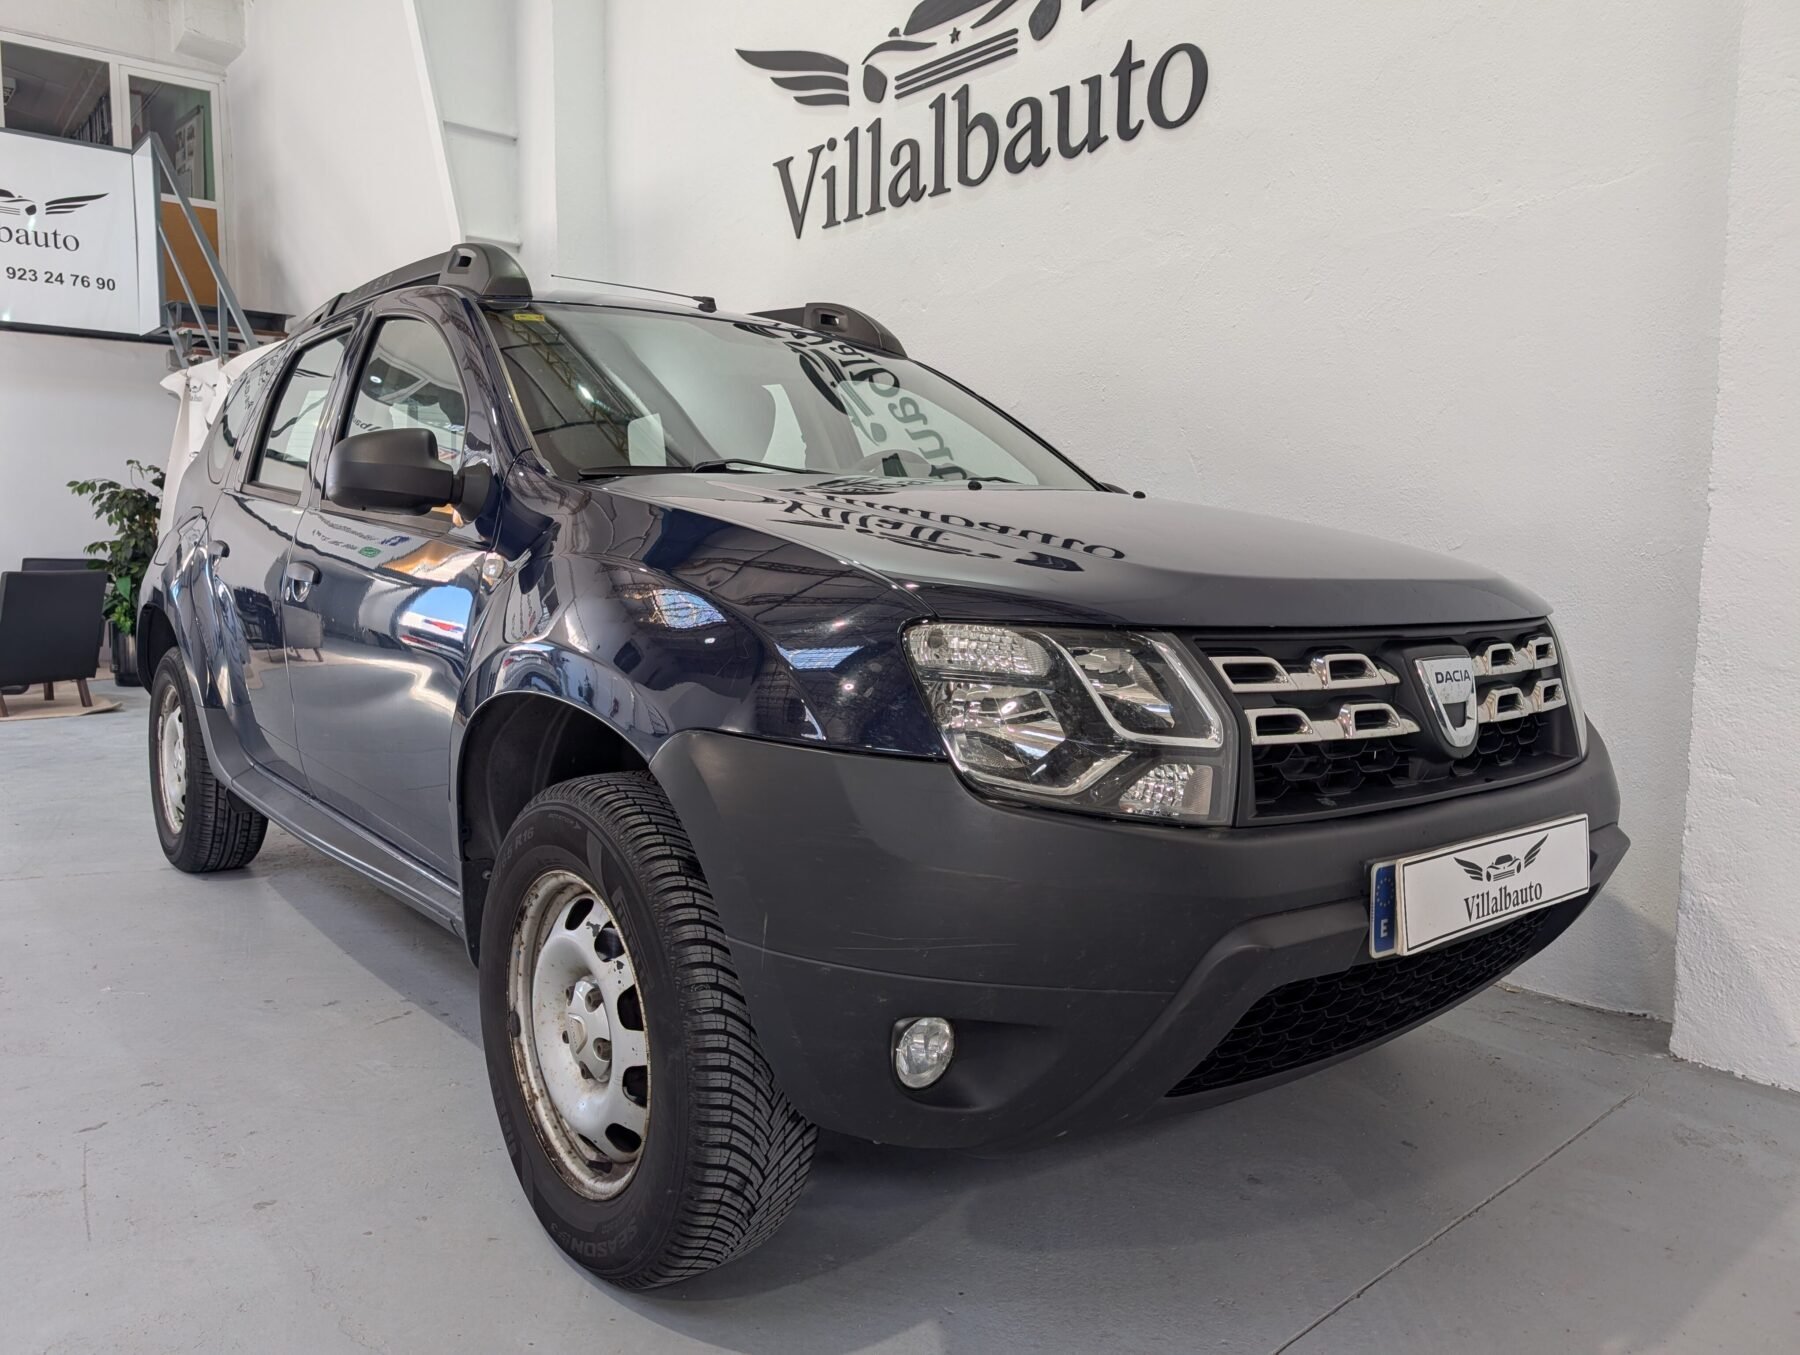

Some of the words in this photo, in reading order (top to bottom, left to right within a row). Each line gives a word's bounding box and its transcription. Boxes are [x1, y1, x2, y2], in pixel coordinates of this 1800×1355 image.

[772, 39, 1209, 240] Villalbauto
[6, 266, 38, 282] 923
[44, 270, 65, 285] 24
[70, 273, 91, 288] 76
[96, 277, 116, 291] 90
[1434, 669, 1471, 684] DACIA
[1463, 881, 1544, 923] Villalbauto
[1380, 918, 1389, 938] E
